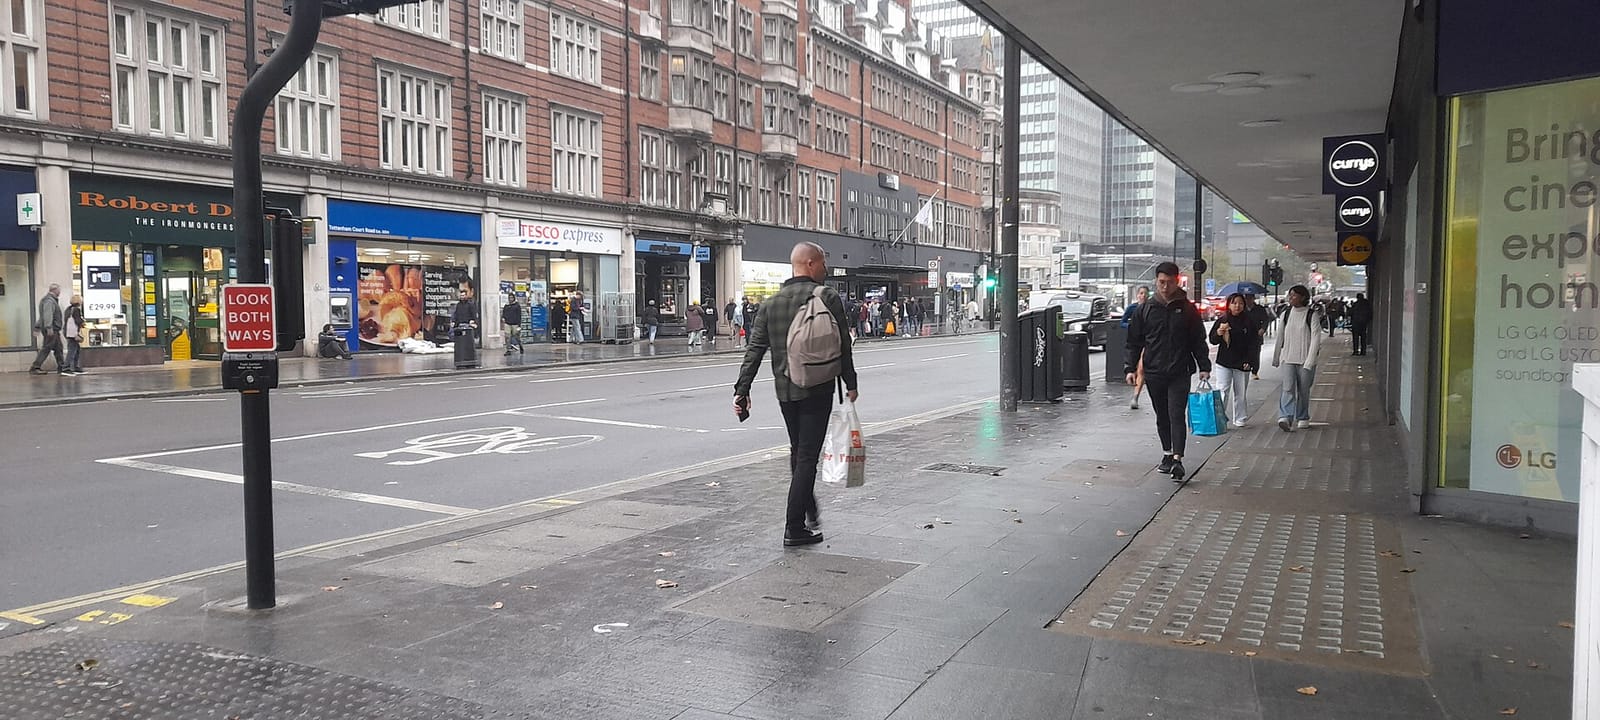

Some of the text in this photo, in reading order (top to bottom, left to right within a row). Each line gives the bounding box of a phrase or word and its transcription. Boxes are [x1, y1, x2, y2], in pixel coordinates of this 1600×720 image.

[1332, 157, 1375, 171] currys
[1503, 175, 1598, 212] cine
[78, 191, 200, 214] Robert
[1341, 207, 1371, 217] currys
[135, 217, 234, 231] THE IRONMONGERS
[520, 224, 560, 239] TESCO
[563, 228, 604, 245] express
[228, 293, 270, 305] LOOK
[89, 303, 116, 311] £29.99
[228, 311, 270, 323] BOTH
[228, 329, 272, 341] WAYS
[1497, 325, 1599, 341] LG G4 OLED
[1497, 347, 1527, 360] and
[1531, 346, 1554, 361] LG
[1527, 449, 1557, 469] LG
